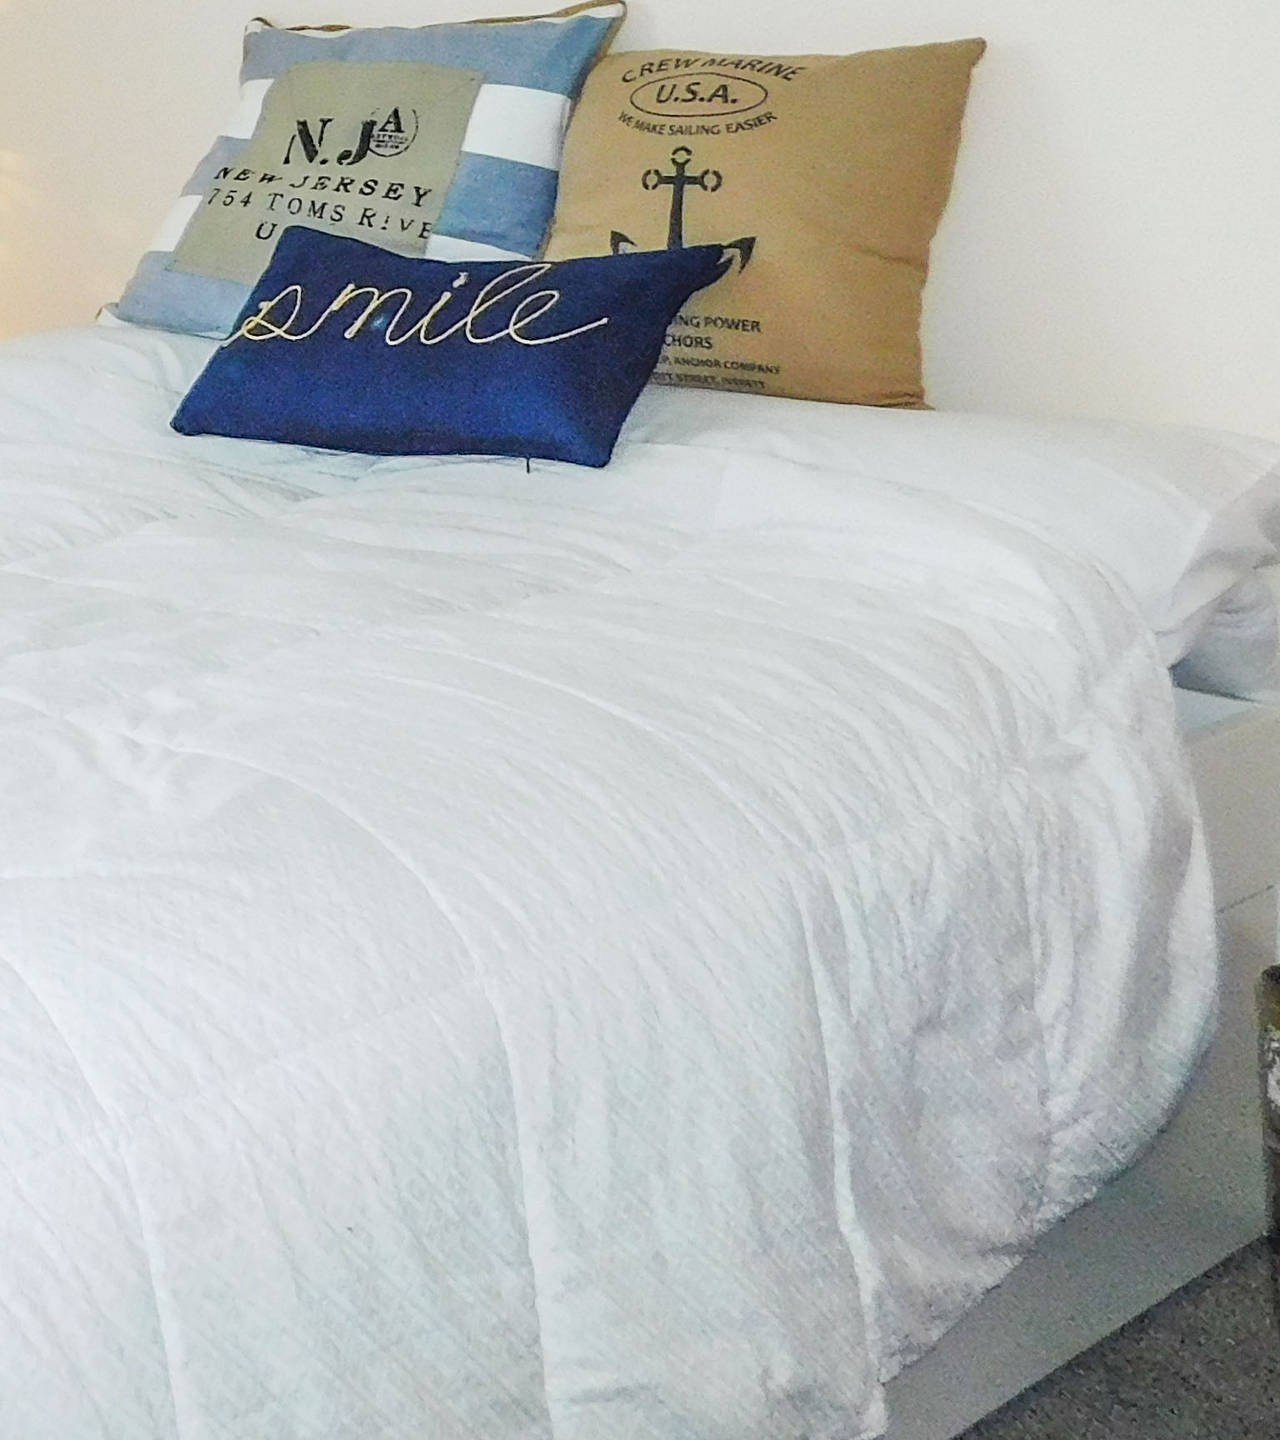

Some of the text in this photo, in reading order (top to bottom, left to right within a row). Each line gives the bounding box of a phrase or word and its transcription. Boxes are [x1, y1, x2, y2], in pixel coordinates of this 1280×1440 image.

[621, 57, 807, 84] CREW MARINE
[655, 81, 739, 104] U.S.A.
[633, 119, 667, 136] MAKE
[667, 123, 721, 137] SAILING
[725, 110, 779, 135] EASIER
[213, 166, 433, 209] NEW JERSEY
[206, 186, 253, 209] 754
[267, 191, 347, 224] TOMS
[217, 262, 609, 350] smile
[703, 315, 762, 333] POWER
